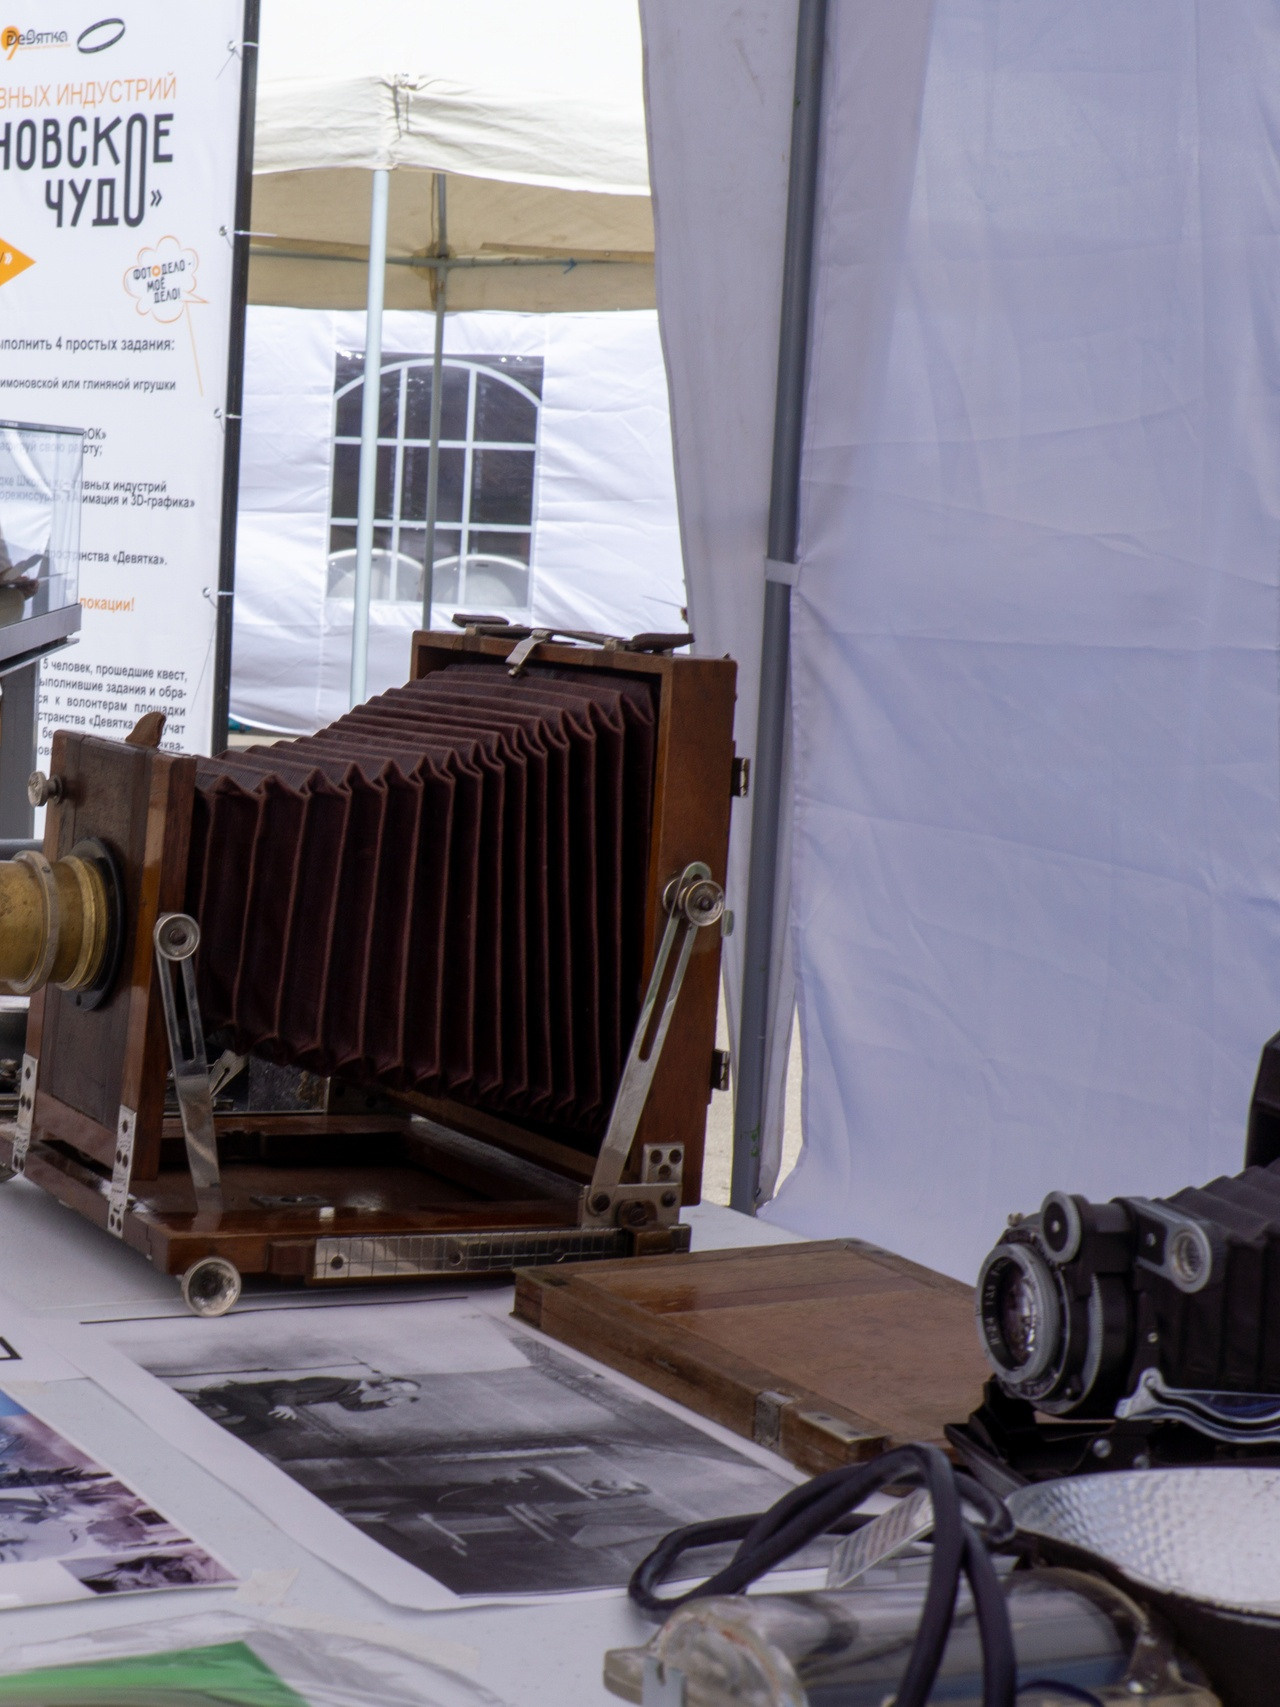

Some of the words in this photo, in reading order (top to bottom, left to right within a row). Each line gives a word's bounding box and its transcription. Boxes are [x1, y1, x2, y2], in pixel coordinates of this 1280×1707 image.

[56, 72, 177, 109] ИНДУСТРИЙ
[133, 259, 185, 280] ФОТОДЕЛО
[55, 336, 63, 350] 4
[65, 339, 118, 354] простых
[120, 339, 175, 353] задания:
[61, 379, 80, 390] или
[82, 378, 131, 391] глиняной
[132, 380, 176, 394] игрушки
[113, 480, 167, 496] индустрий
[82, 494, 119, 506] имация
[121, 496, 128, 505] и
[130, 494, 195, 510] 3D-графика»
[112, 551, 167, 566] «Девятка».
[43, 658, 49, 670] 5
[51, 661, 93, 675] человек,
[95, 664, 154, 679] прошедшие
[157, 669, 188, 682] квест,
[39, 678, 103, 692] ыполнившие
[106, 683, 146, 695] задания
[149, 687, 156, 696] и
[159, 685, 187, 701] обра-
[37, 694, 48, 704] ся
[55, 696, 61, 705] к
[67, 697, 128, 713] волонтерам
[36, 711, 86, 724] странства
[88, 714, 135, 730] «Девятка
[163, 724, 186, 736] учат
